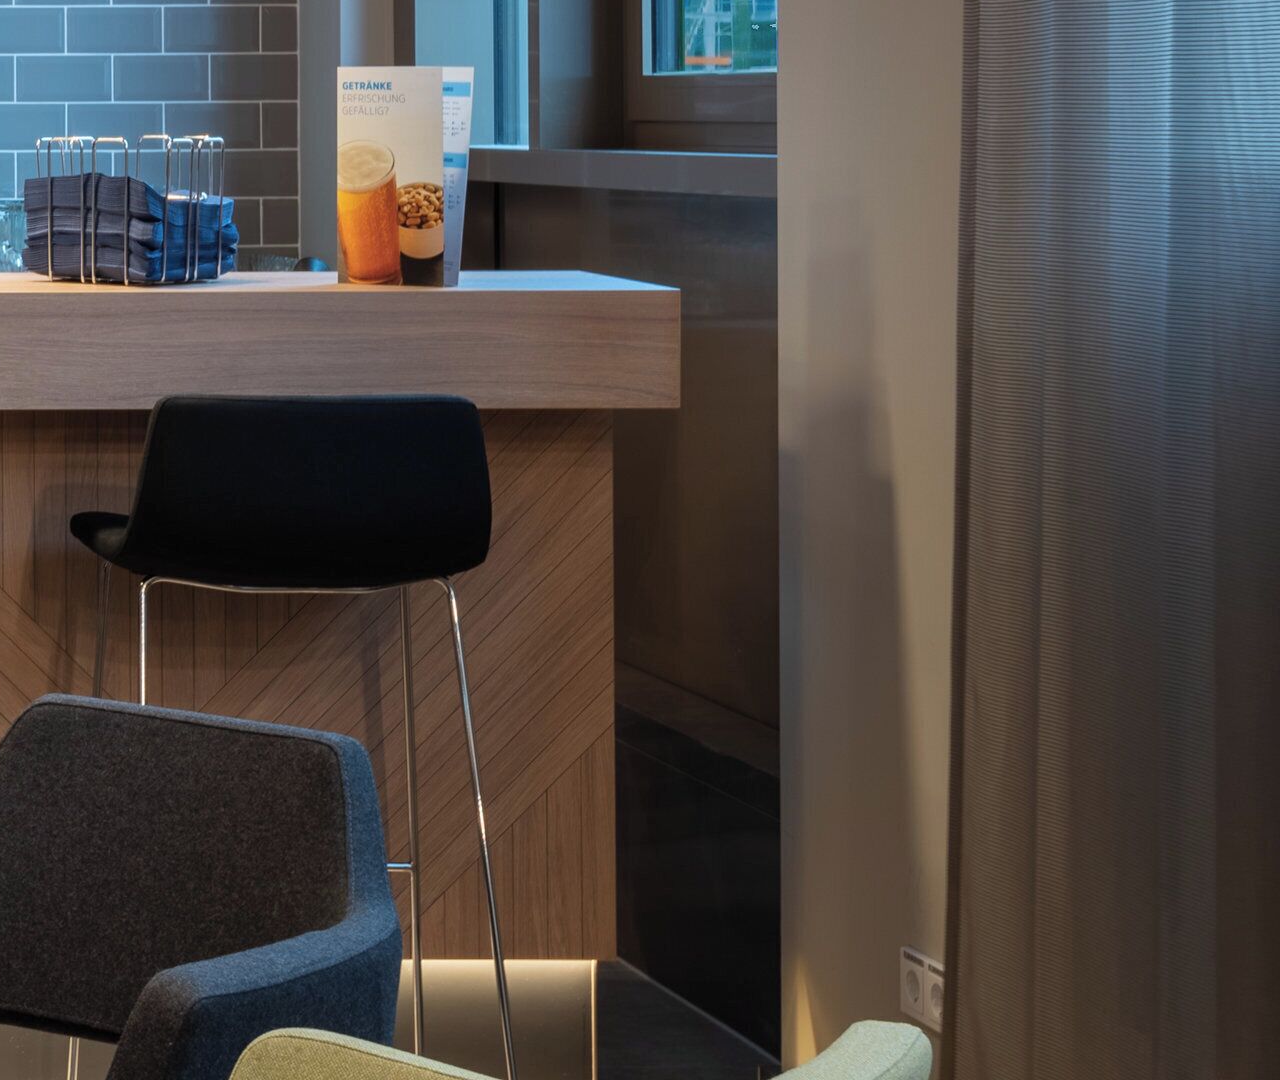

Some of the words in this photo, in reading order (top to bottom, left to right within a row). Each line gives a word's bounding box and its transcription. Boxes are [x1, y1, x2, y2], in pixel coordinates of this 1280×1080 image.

[342, 80, 392, 91] GETRÄNKE
[342, 93, 406, 104] ERFRISCHUNG
[342, 105, 389, 116] GEFÄLLIG?
